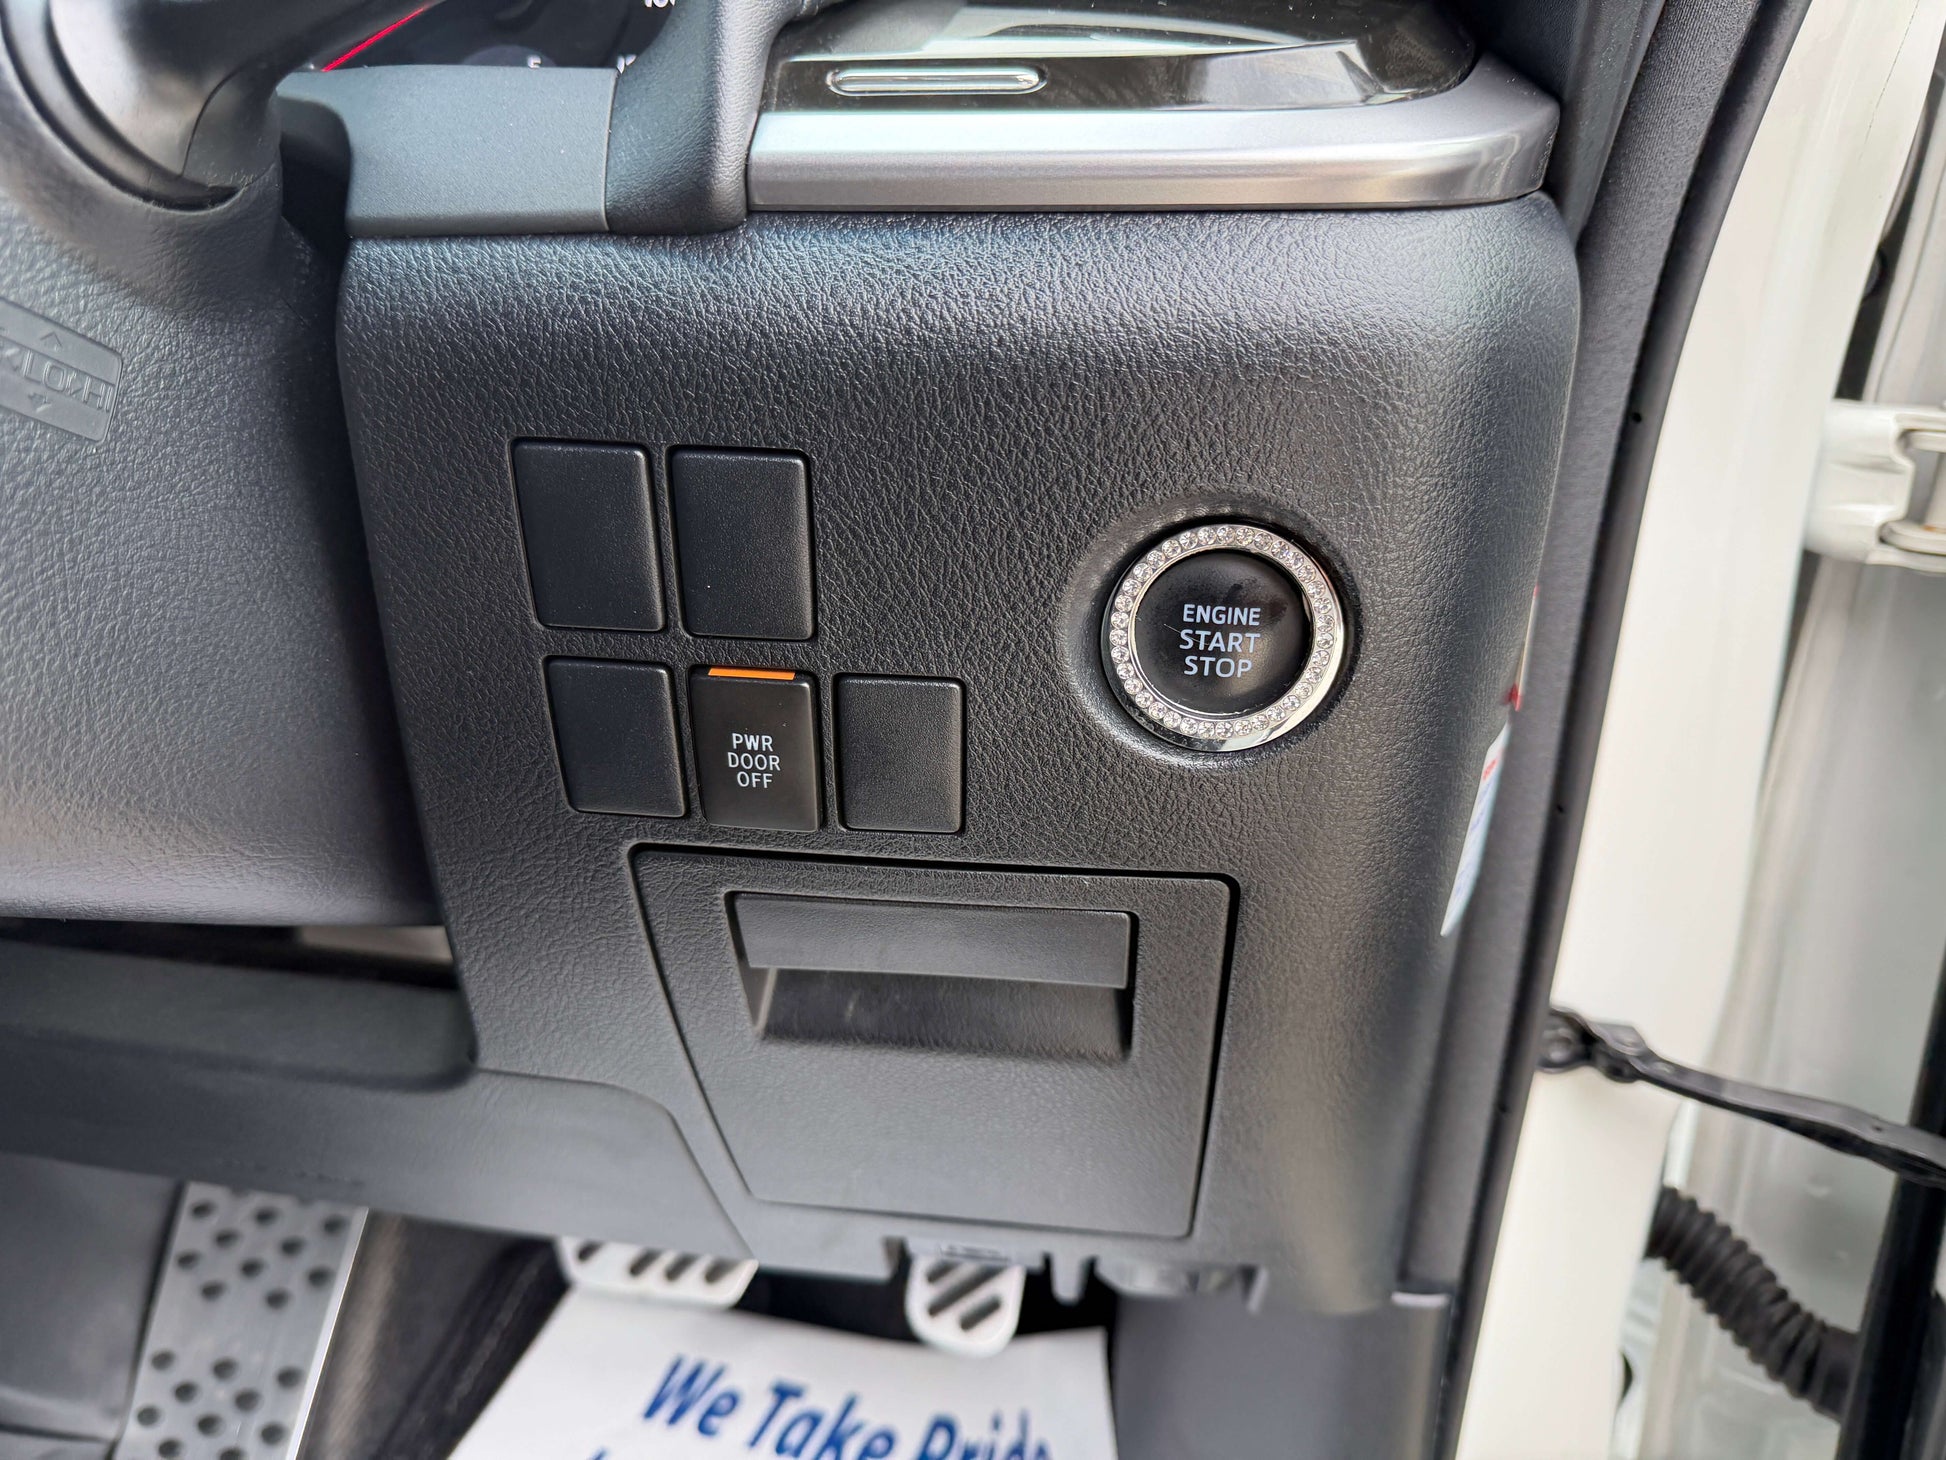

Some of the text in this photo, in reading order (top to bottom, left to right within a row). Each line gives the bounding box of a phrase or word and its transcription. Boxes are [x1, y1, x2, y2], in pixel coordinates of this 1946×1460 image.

[1182, 603, 1261, 626] ENGINE
[1179, 629, 1261, 653] START
[1183, 655, 1252, 678] STOP
[731, 732, 774, 752] PWR
[727, 751, 781, 771] DOOR
[736, 771, 773, 789] OFF
[643, 1355, 740, 1437] We
[748, 1376, 896, 1460] Take
